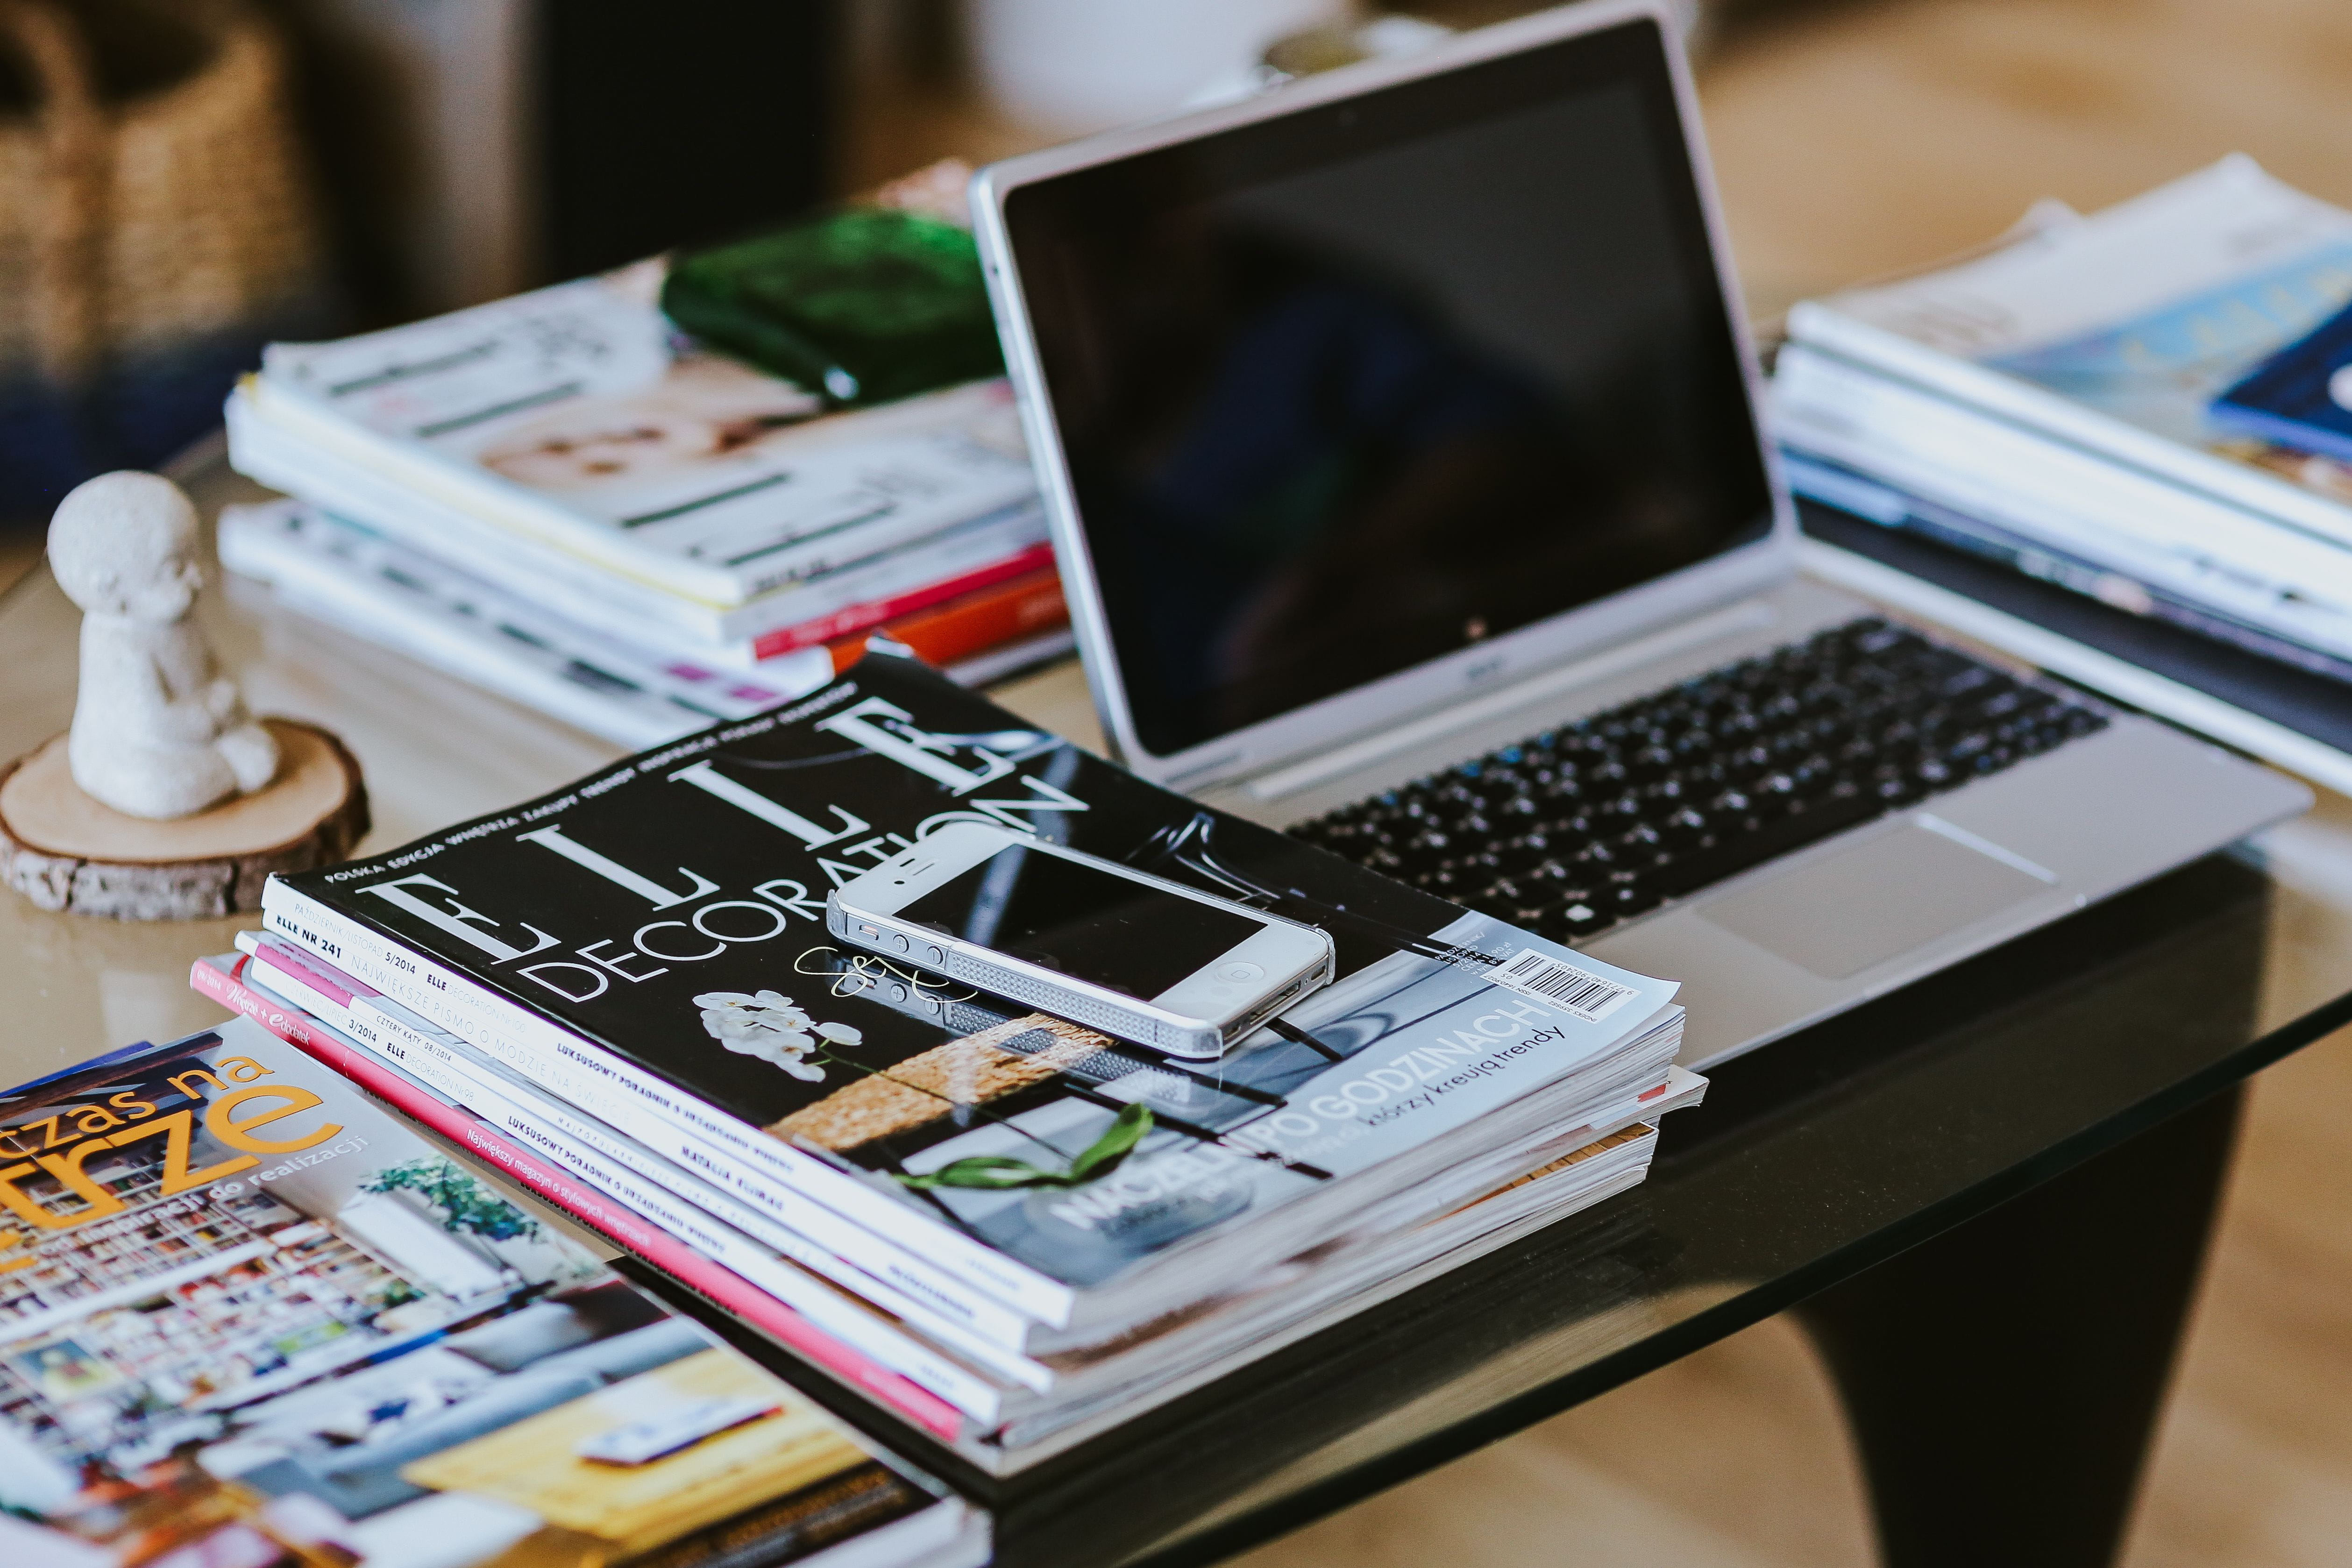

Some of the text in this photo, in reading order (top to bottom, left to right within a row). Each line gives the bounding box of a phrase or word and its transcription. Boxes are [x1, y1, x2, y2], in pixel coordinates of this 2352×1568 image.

[354, 696, 1016, 963] ELLE
[325, 865, 386, 883] POLSKA
[1443, 945, 1478, 965] LISTOPAD
[1453, 952, 1481, 968] 5/2014
[1461, 958, 1485, 972] CENA
[1556, 963, 1588, 978] 902405
[276, 915, 299, 935] ELLE
[301, 928, 318, 946] NR
[321, 940, 342, 959] 241
[351, 955, 429, 1009] NAJWIĘKSZE
[433, 1002, 475, 1036] PISMO
[480, 1029, 489, 1043] O
[494, 1039, 547, 1077] MODZIE
[551, 1071, 569, 1089] NA
[295, 903, 383, 958] PAŹDZIERNIK/LISTOPAD
[385, 952, 416, 975] 5/2014
[427, 974, 447, 992] ELLE
[448, 983, 499, 1021] DECORATION
[557, 1043, 617, 1080] LUKSUSOWY
[376, 1015, 403, 1034] CZTERY
[403, 1029, 422, 1045] KĄTY
[423, 1042, 452, 1062] 08/2014
[1423, 1063, 1506, 1095] kreują
[1492, 1026, 1566, 1062] trendy
[167, 1056, 275, 1100] na
[348, 1019, 377, 1043] 3/2014
[386, 1043, 405, 1061] ELLE
[406, 1052, 454, 1090] DECORATION
[464, 1088, 474, 1101] 98
[507, 1115, 563, 1156] LUKSUSOWY
[564, 1150, 611, 1186] PORADNIK
[614, 1181, 620, 1190] O
[1244, 1113, 1320, 1149] PO
[1309, 999, 1552, 1120] GODZINACH
[209, 1180, 243, 1200] do
[247, 1135, 370, 1188] realizacji
[467, 1128, 513, 1166] Największy
[514, 1158, 553, 1190] magazyn
[553, 1184, 559, 1193] o
